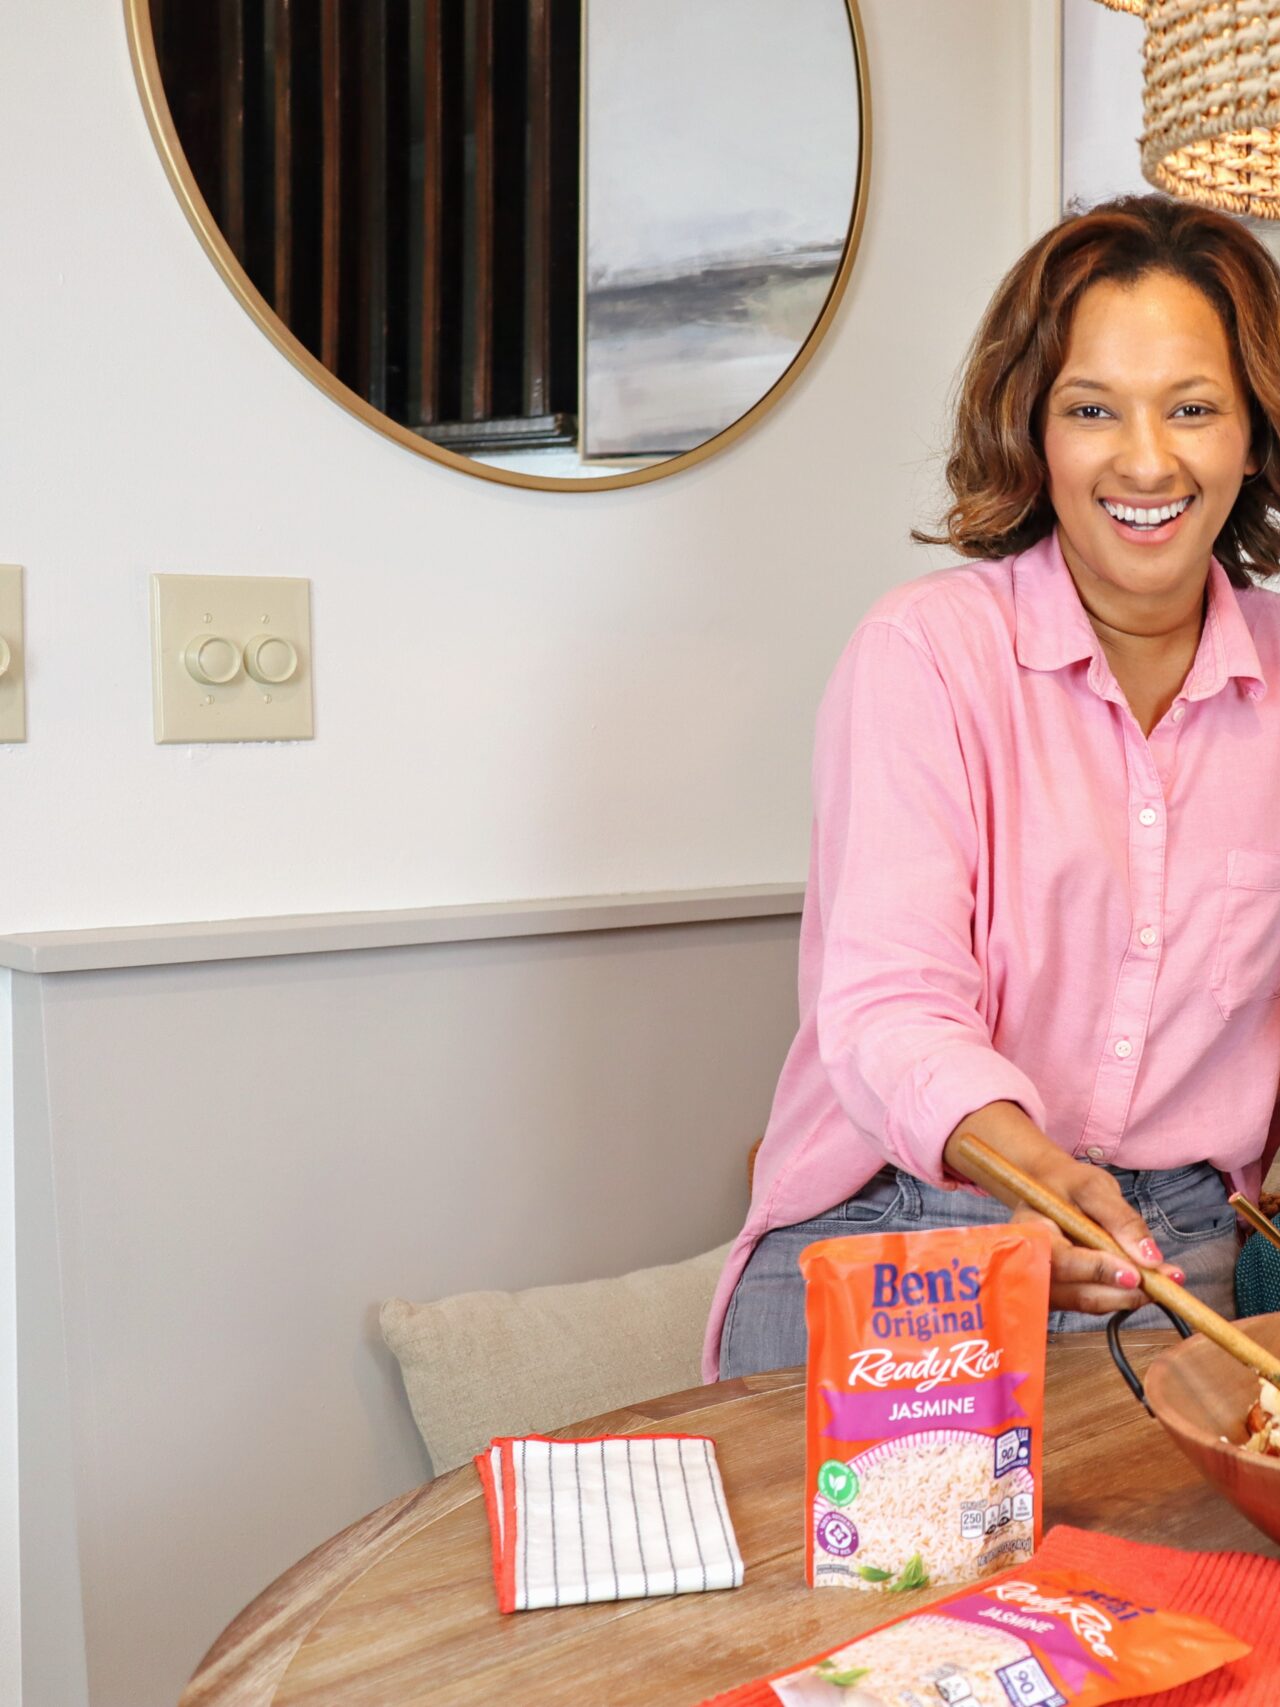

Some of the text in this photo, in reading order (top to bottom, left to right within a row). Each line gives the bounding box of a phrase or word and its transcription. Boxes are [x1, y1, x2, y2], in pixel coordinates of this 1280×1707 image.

[872, 1257, 981, 1309] Ben's
[872, 1303, 984, 1342] Original
[848, 1346, 952, 1393] Ready
[888, 1396, 976, 1422] JASMINE
[963, 1513, 981, 1525] 250
[978, 1606, 1055, 1634] JASMINE
[1057, 1602, 1114, 1658] Rice
[1014, 1670, 1035, 1694] 90
